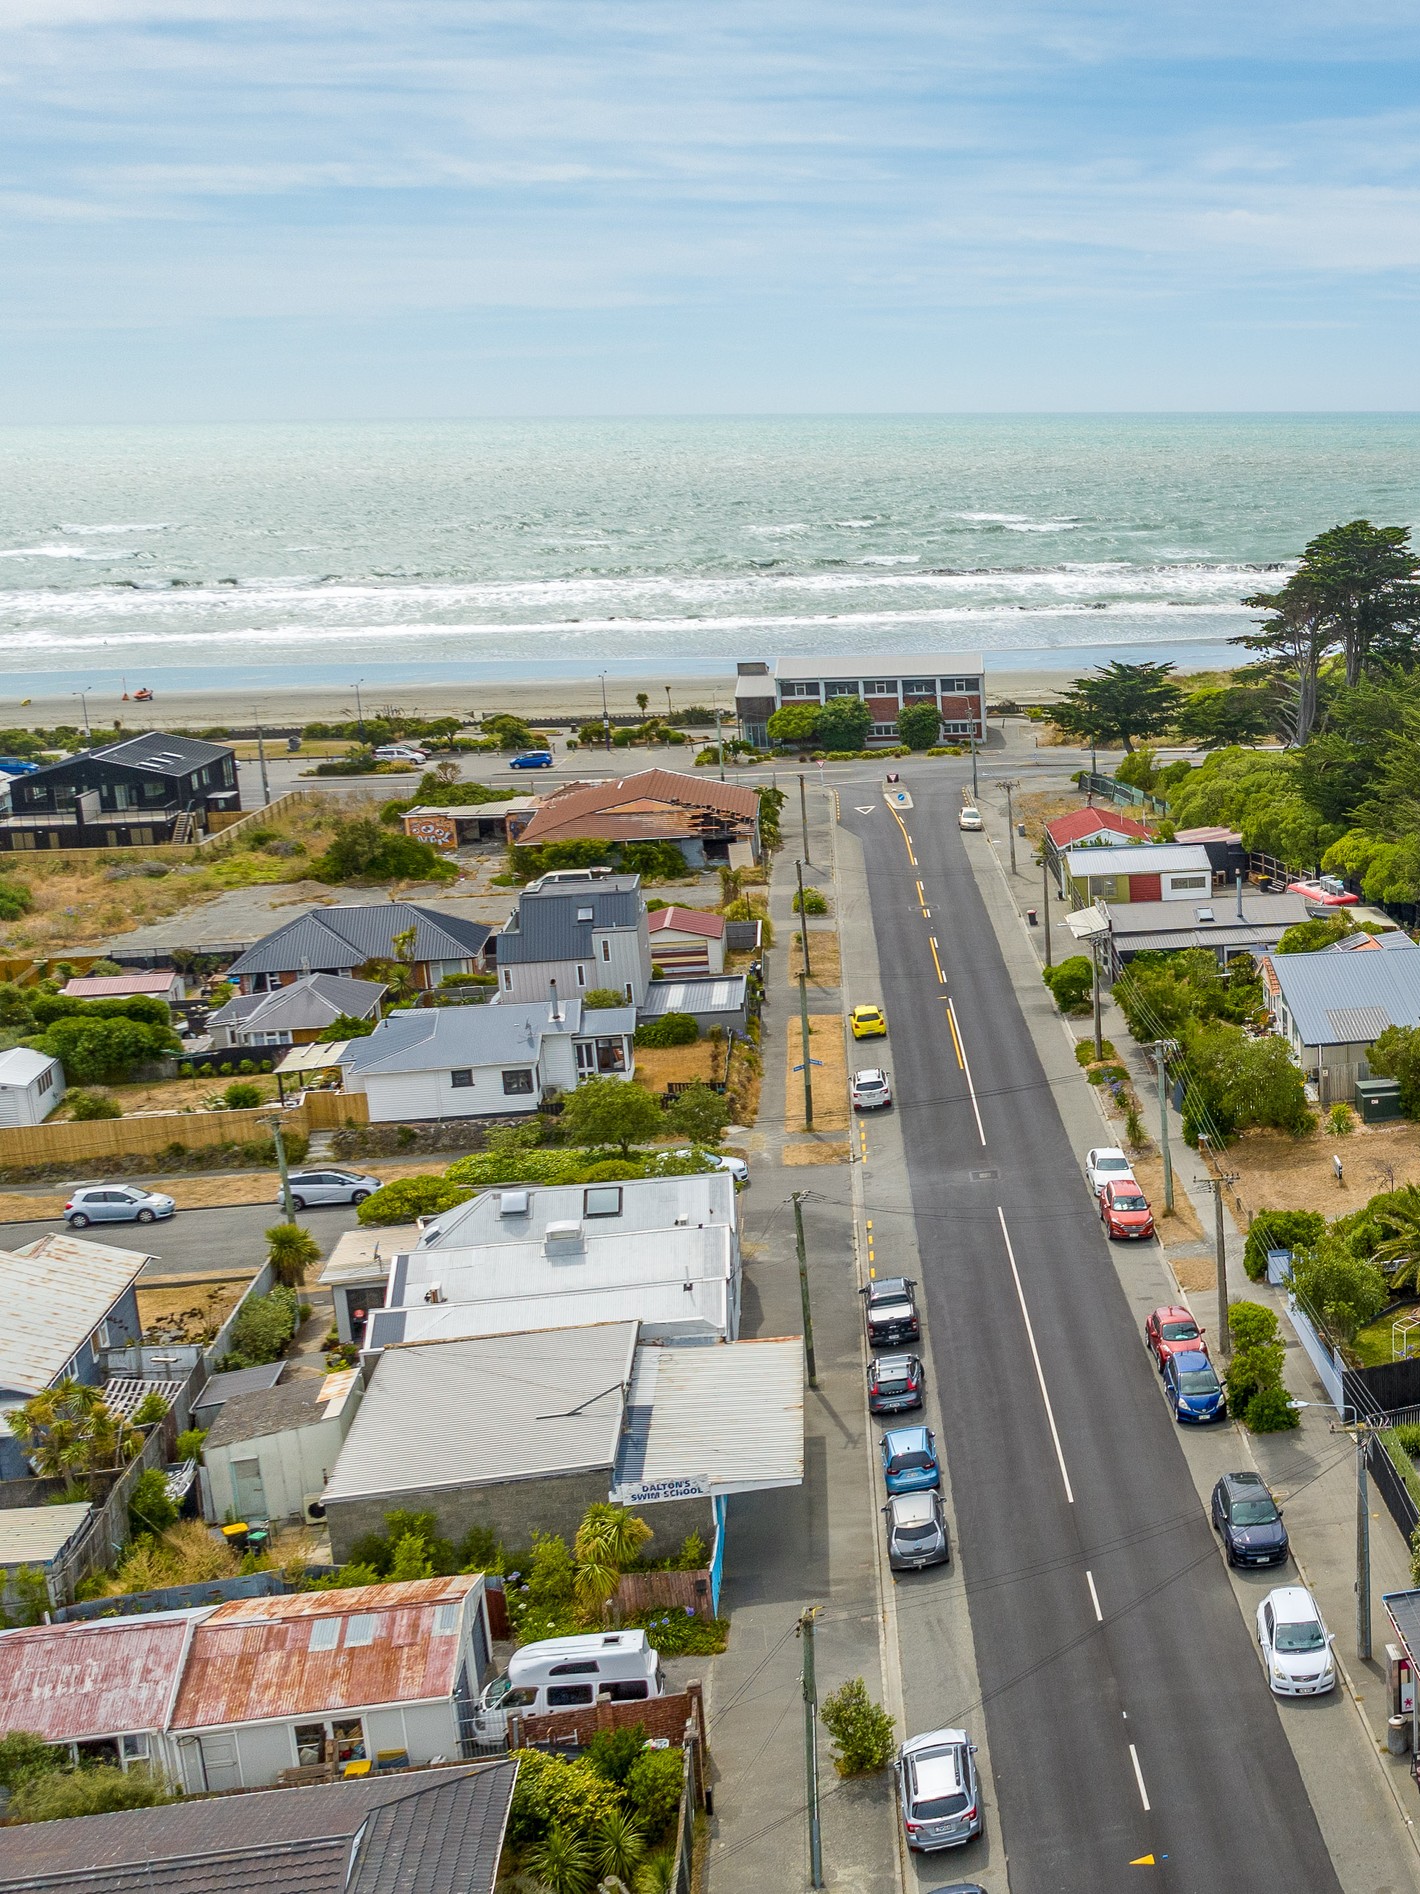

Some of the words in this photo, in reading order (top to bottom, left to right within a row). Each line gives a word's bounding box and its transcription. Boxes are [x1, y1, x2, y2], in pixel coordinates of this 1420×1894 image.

[642, 1479, 691, 1493] DALTON'S
[631, 1491, 660, 1501] SWIM
[663, 1486, 704, 1499] SCHOOL
